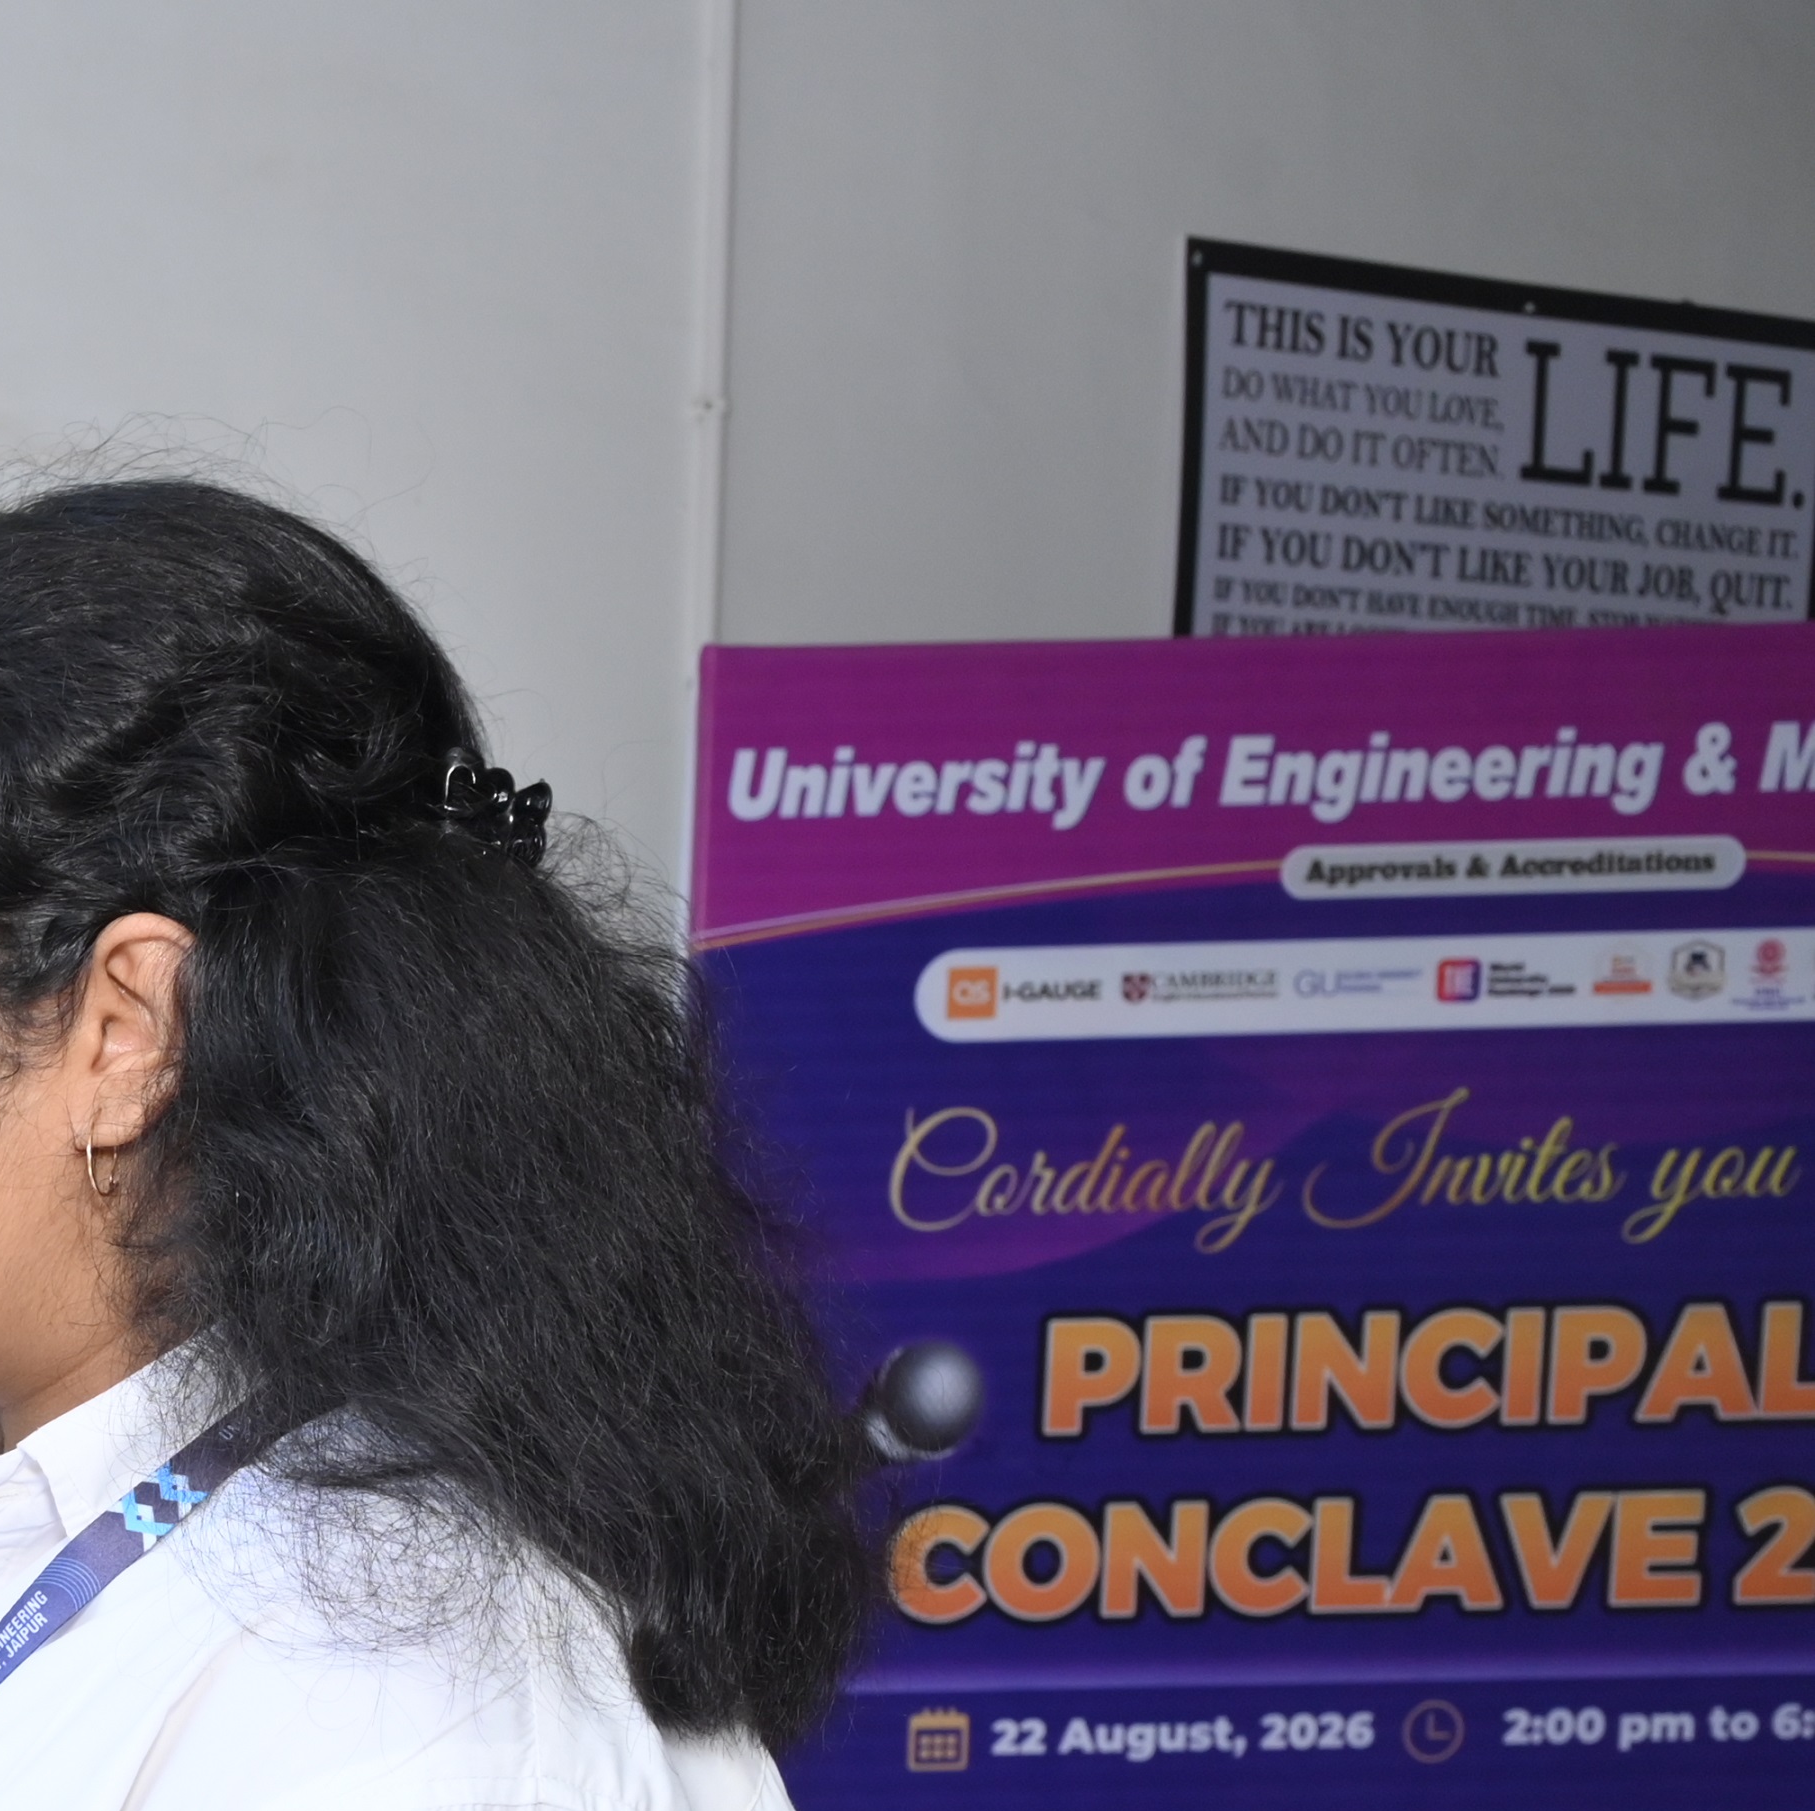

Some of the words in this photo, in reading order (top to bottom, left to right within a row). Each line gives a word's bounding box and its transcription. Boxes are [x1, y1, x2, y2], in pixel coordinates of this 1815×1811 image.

[1224, 299, 1326, 356] THIS
[1336, 314, 1374, 363] IS
[1385, 319, 1500, 379] YOUR
[1222, 365, 1265, 401] DO
[1272, 371, 1359, 413] WHAT
[1364, 382, 1424, 422] YOU
[1519, 339, 1805, 511] LIFE.
[1221, 415, 1290, 456] AND
[1296, 421, 1344, 463] DO
[1351, 428, 1387, 467] IT
[1220, 473, 1249, 507] IF
[1254, 478, 1315, 514] YOU
[1319, 483, 1410, 523] DON'T
[1414, 493, 1476, 530] LIKE
[1655, 517, 1763, 558] CHANGE
[1218, 522, 1254, 562] IF
[1258, 526, 1334, 571] YOU
[1341, 534, 1452, 581] DON'T
[1457, 545, 1534, 589] LIKE
[1540, 552, 1631, 596] YOUR
[1636, 562, 1702, 609] JOB,
[1708, 567, 1794, 616] QUIT.
[1241, 578, 1288, 608] YOU
[726, 741, 1107, 831] University
[1124, 735, 1208, 811] of
[1220, 726, 1665, 824] Engineering
[1683, 721, 1738, 796] &
[1305, 854, 1457, 888] Approvals
[1467, 853, 1488, 877] &
[1499, 850, 1716, 879] Accreditations
[889, 1105, 1283, 1253] Cordially
[1302, 1086, 1629, 1230] Invites
[1621, 1140, 1803, 1245] you
[1041, 1302, 1815, 1438] PRINCIPAL
[890, 1489, 1708, 1623] CONCLAVE
[4, 1612, 48, 1659] JAIPUR
[991, 1718, 1055, 1756] 22
[1058, 1715, 1248, 1762] August,
[1259, 1711, 1376, 1754] 2026
[1502, 1707, 1607, 1748] 2:00
[1617, 1713, 1697, 1754] pm
[1708, 1704, 1760, 1742] to
